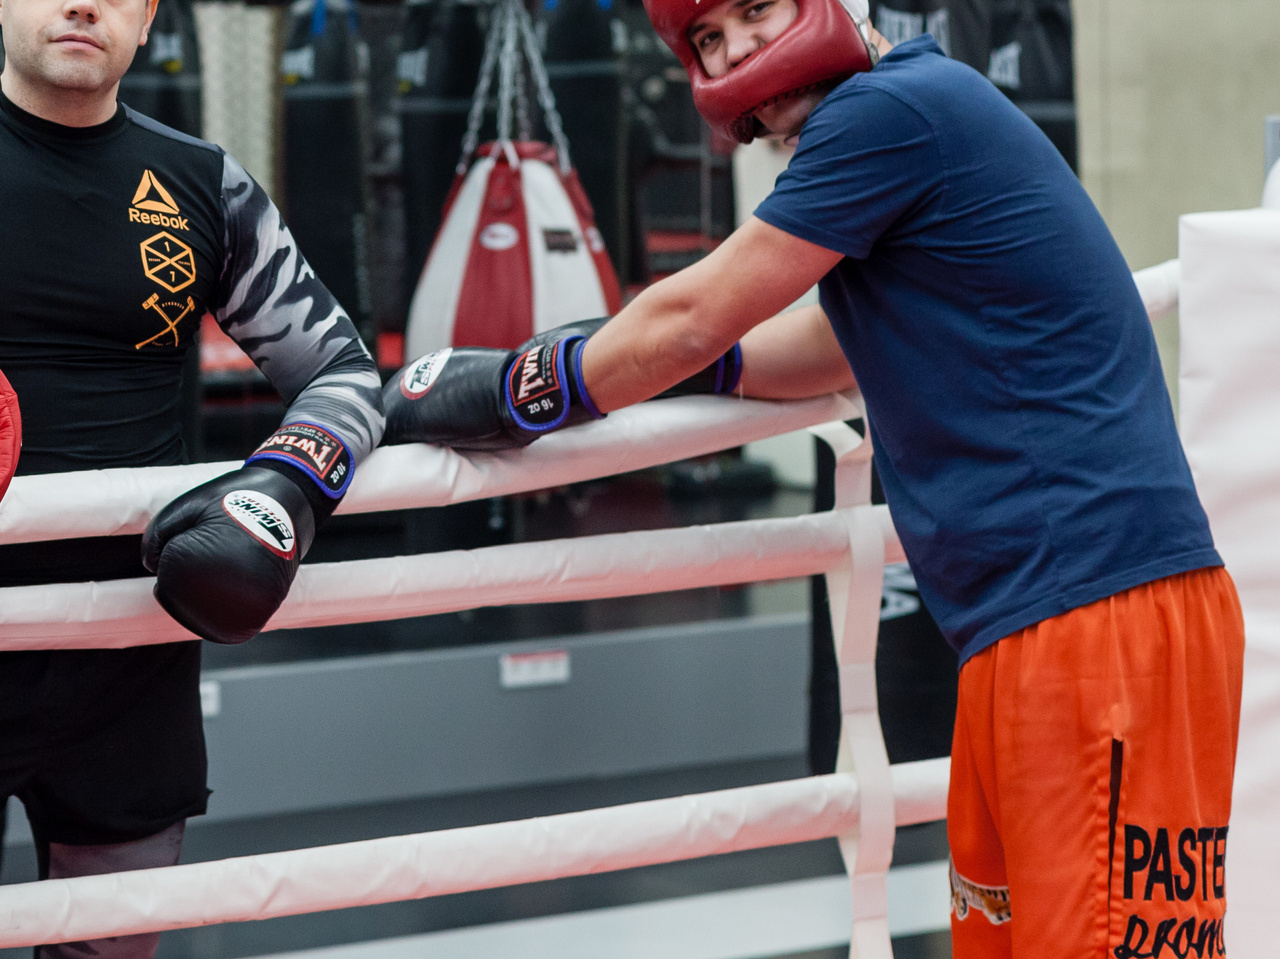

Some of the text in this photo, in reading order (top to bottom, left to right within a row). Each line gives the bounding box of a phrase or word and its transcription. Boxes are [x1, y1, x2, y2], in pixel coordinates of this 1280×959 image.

[128, 207, 191, 232] Reebok
[541, 397, 554, 410] 16
[337, 462, 347, 476] 10
[228, 498, 293, 550] TWINS
